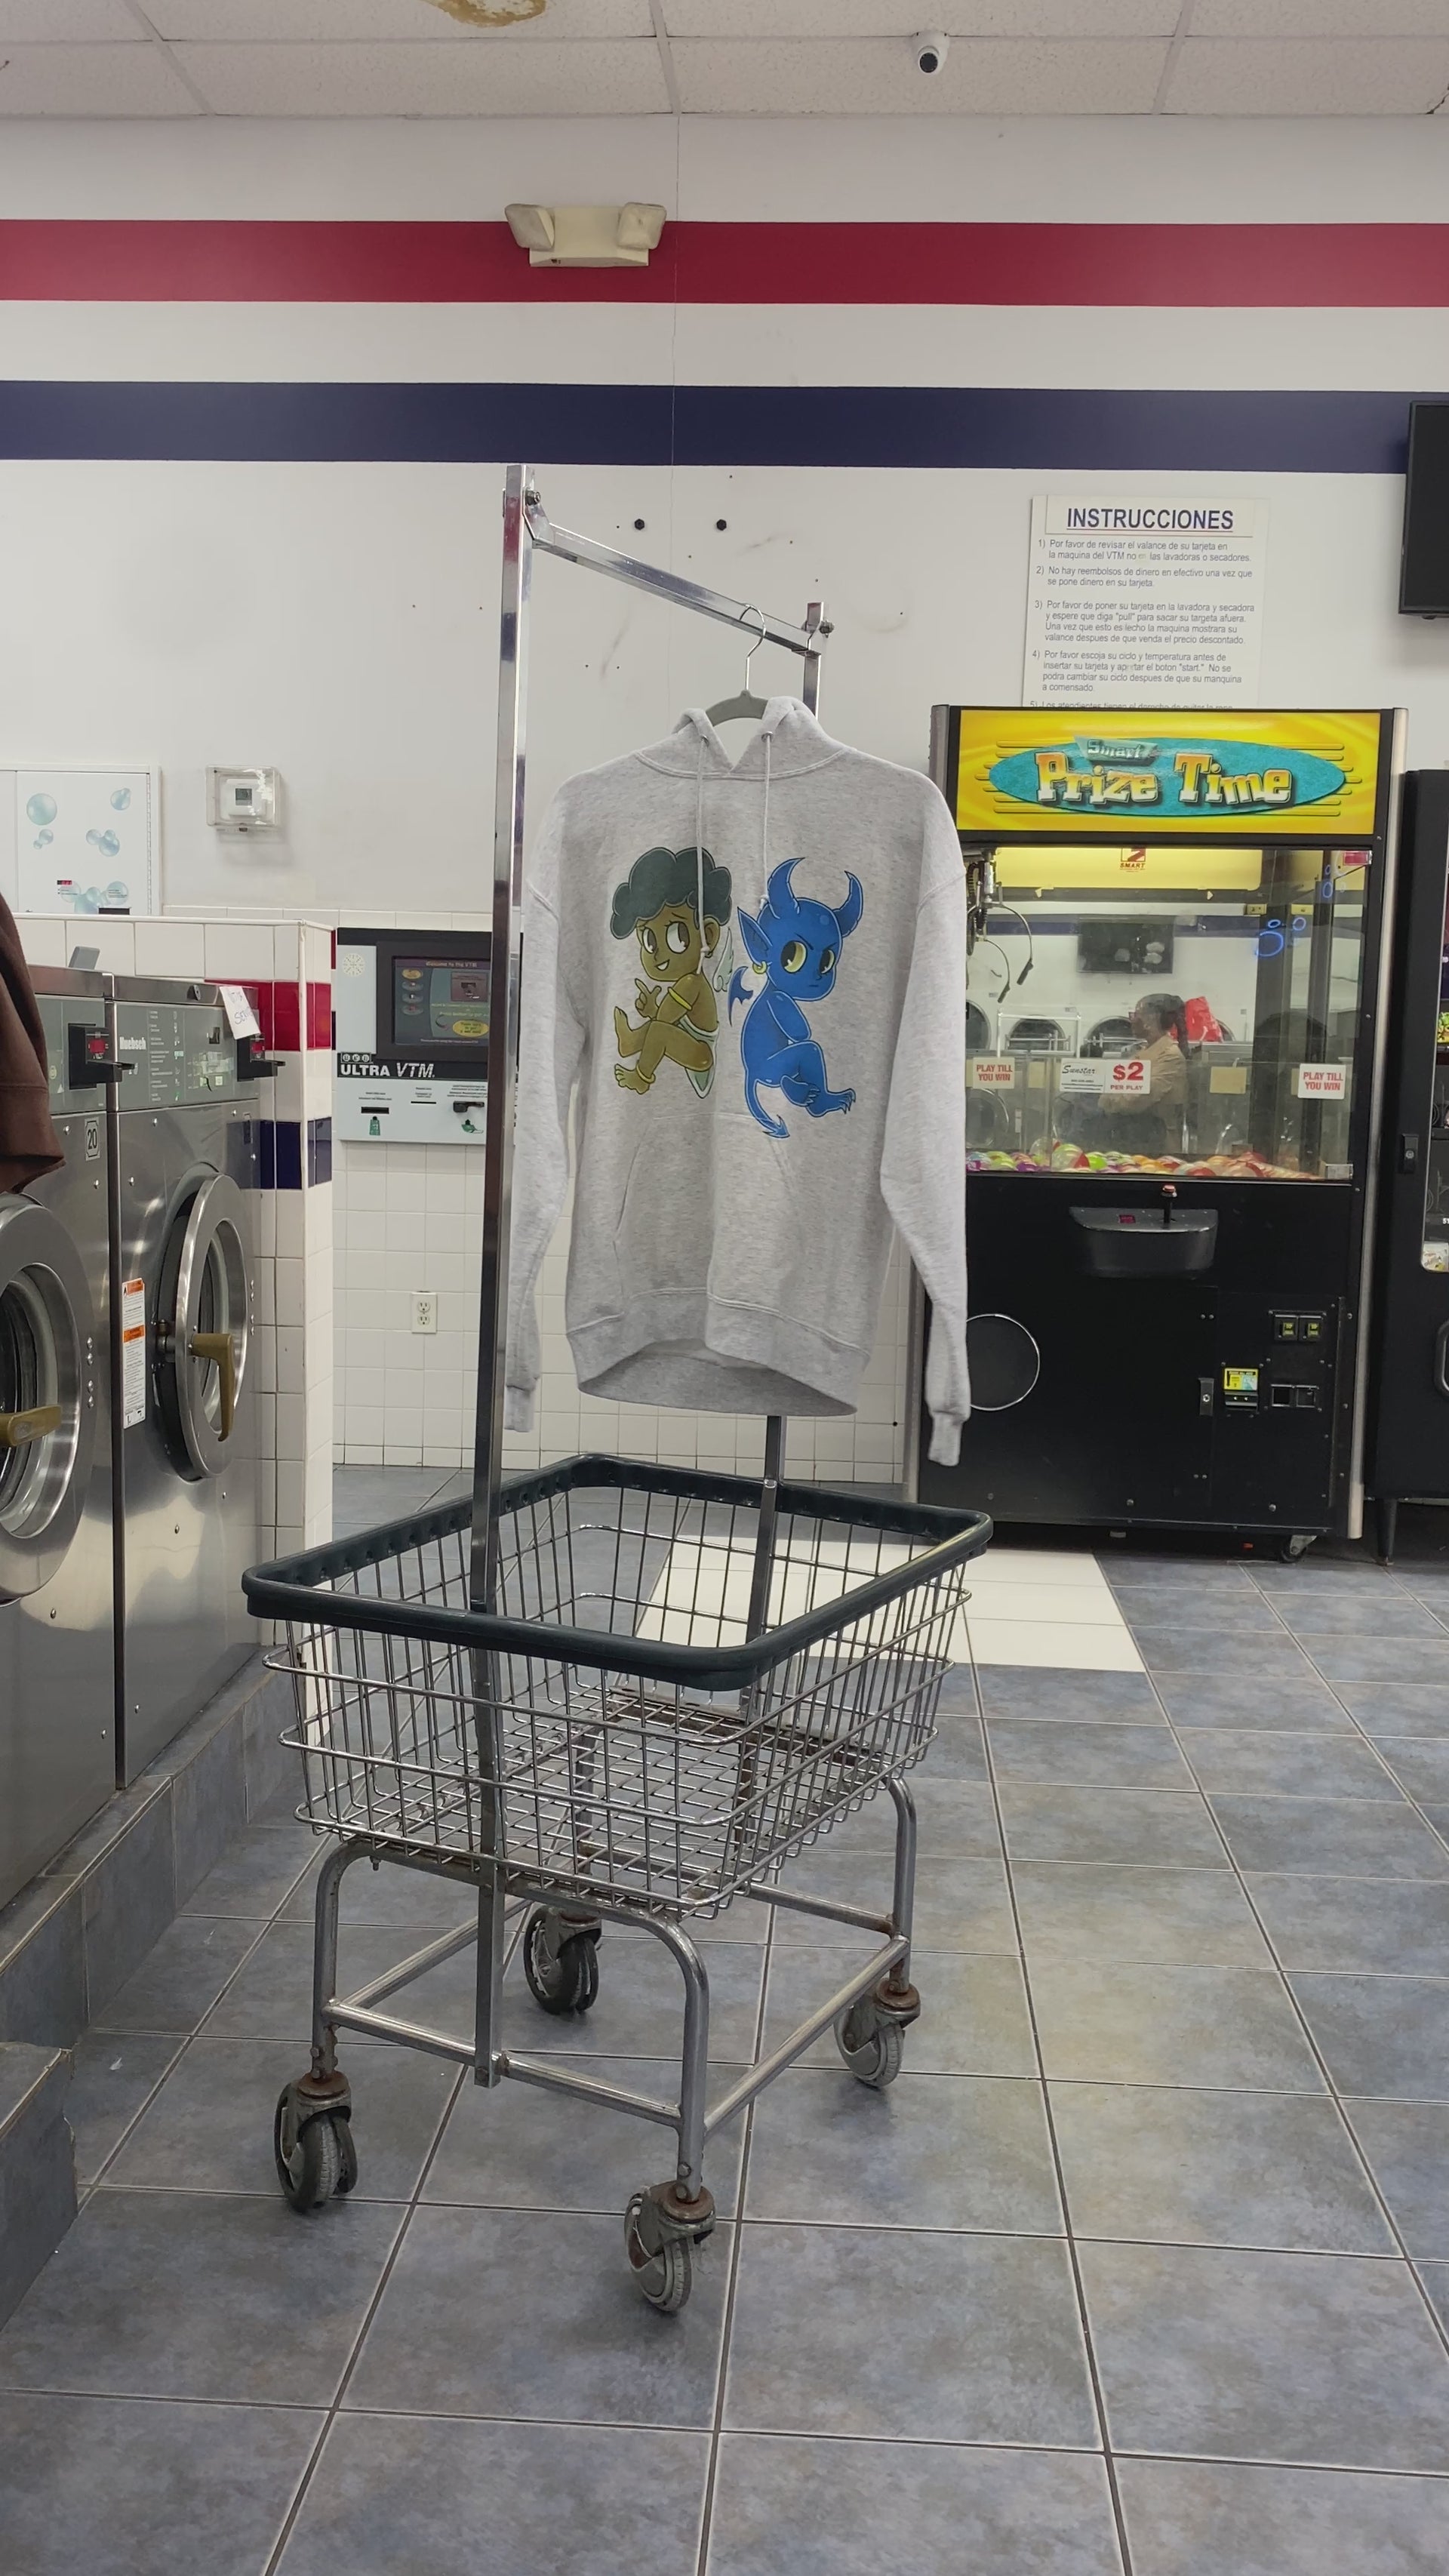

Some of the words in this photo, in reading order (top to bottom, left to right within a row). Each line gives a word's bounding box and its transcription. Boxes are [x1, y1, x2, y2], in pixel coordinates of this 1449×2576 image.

[1067, 508, 1233, 529] INSTRUCCIONES
[1038, 539, 1045, 549] 1)
[1050, 540, 1063, 548] Por
[1066, 540, 1084, 548] favor
[1137, 541, 1166, 549] valance
[1192, 542, 1216, 552] tarjeta
[1049, 550, 1055, 559] la
[1057, 552, 1091, 561] maquina
[1150, 552, 1161, 560] las
[1163, 552, 1200, 561] lavadoras
[1210, 553, 1251, 562] secadores.
[1035, 565, 1044, 575] 2)
[1048, 566, 1060, 574] No
[1062, 566, 1075, 577] hay
[1078, 567, 1121, 575] reembolsos
[1136, 568, 1159, 576] dinero
[1174, 568, 1203, 577] efectivo
[1238, 571, 1253, 579] que
[1035, 600, 1043, 610] 3)
[1047, 600, 1060, 608] Por
[1063, 600, 1081, 609] favor
[1084, 601, 1093, 609] de
[1131, 602, 1154, 612] tarjeta
[1177, 603, 1210, 611] lavadora
[1097, 613, 1113, 622] diga
[1045, 622, 1061, 630] Una
[1079, 624, 1093, 632] que
[1156, 624, 1189, 633] maquina
[1045, 632, 1074, 641] valance
[1076, 633, 1108, 642] despues
[1122, 636, 1137, 644] que
[1174, 636, 1197, 645] precio
[1032, 651, 1040, 660] 4)
[1060, 651, 1079, 659] favor
[1081, 652, 1105, 661] escoja
[1145, 653, 1191, 661] temperatura
[1085, 663, 1108, 672] tarjeta
[1043, 673, 1064, 682] podra
[1130, 674, 1161, 683] despues
[1176, 676, 1190, 684] que
[1087, 739, 1142, 759] Smart
[1035, 752, 1159, 805] Prize
[1174, 753, 1293, 805] Time
[119, 1036, 146, 1050] Huebsch
[340, 1064, 390, 1076] ULTRA
[977, 1064, 995, 1073] PLAY
[998, 1064, 1013, 1073] TILL
[1062, 1060, 1095, 1074] Sunstar
[1113, 1061, 1144, 1081] $2
[1303, 1072, 1324, 1080] PLAY
[1327, 1073, 1343, 1081] TILL
[1305, 1082, 1321, 1090] YOU
[1324, 1082, 1340, 1091] WIN
[88, 1128, 97, 1150] 20
